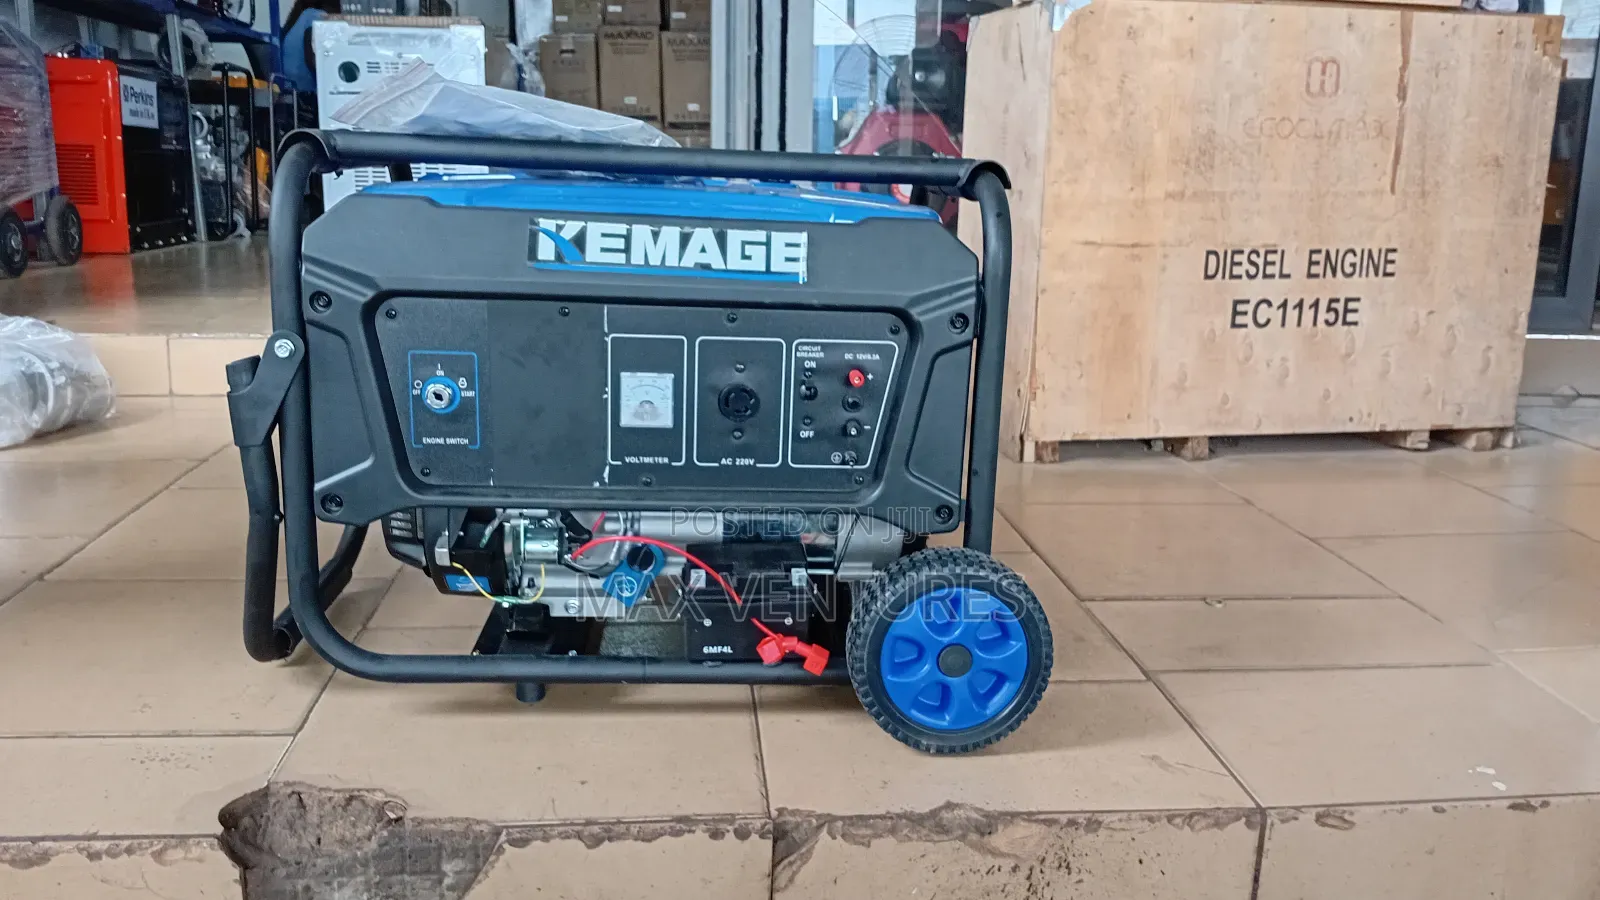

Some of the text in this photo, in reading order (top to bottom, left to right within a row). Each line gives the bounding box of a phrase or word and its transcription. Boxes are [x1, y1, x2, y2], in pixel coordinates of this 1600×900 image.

[129, 86, 154, 107] Perkins
[536, 217, 807, 273] KEMAGE
[1203, 247, 1399, 281] DIESEL ENGINE
[1230, 297, 1362, 329] EC1115E
[804, 360, 816, 369] ON
[412, 388, 421, 396] OFF
[461, 390, 476, 398] START
[800, 430, 815, 439] OFF
[422, 437, 469, 446] ENGINE SWITCH
[624, 456, 670, 465] VOLTMETER
[720, 457, 755, 467] AC 220V
[702, 645, 734, 654] 6MF4L
